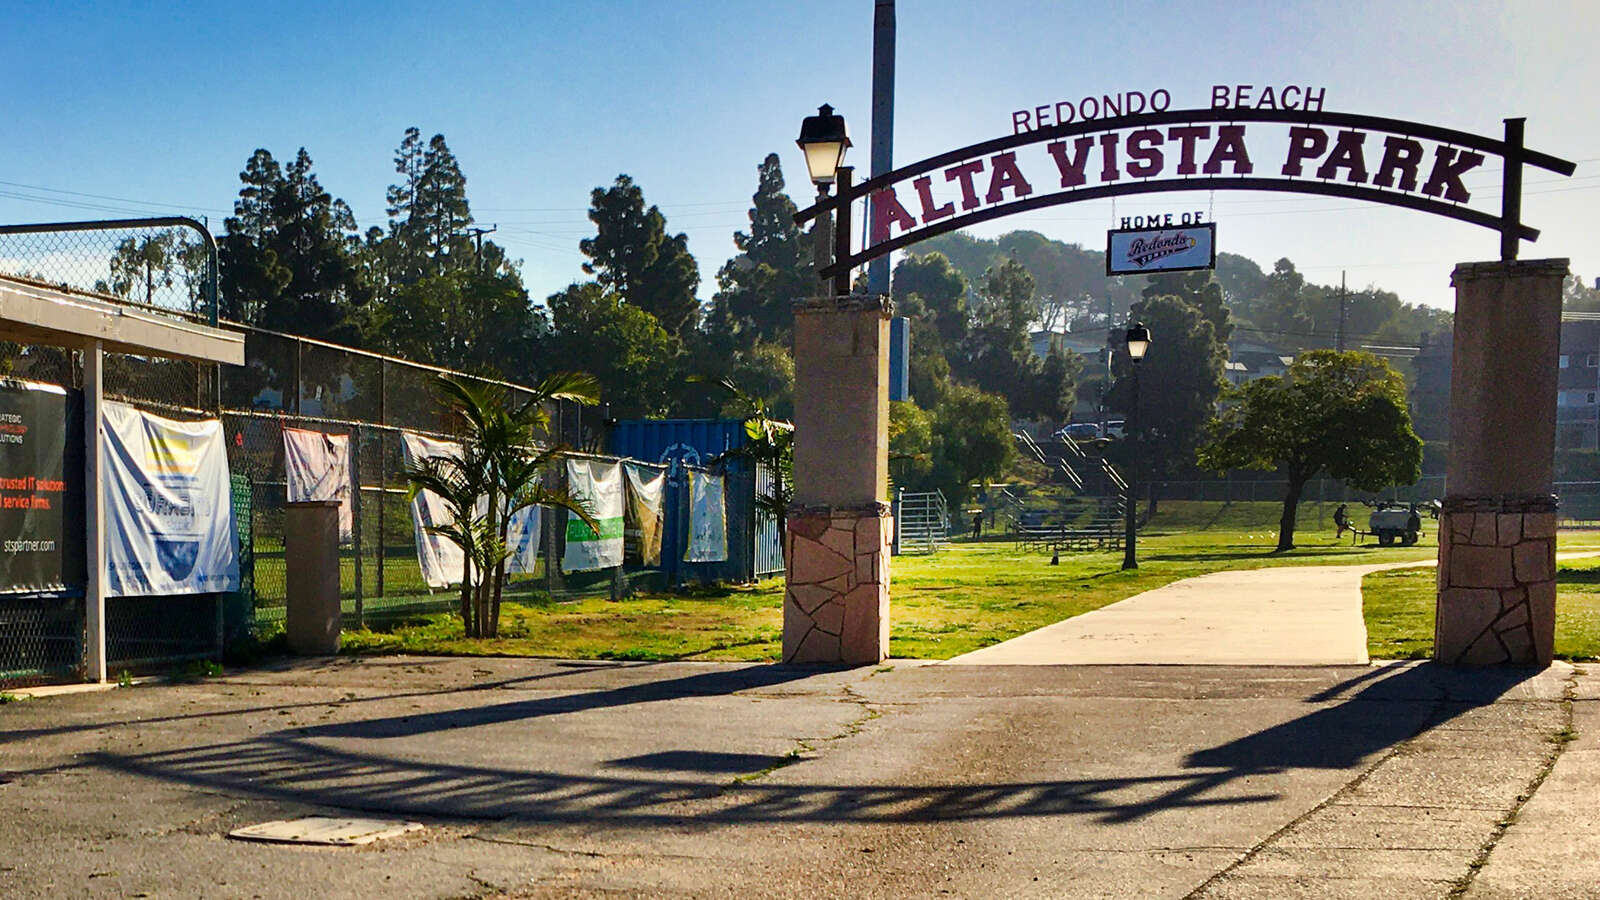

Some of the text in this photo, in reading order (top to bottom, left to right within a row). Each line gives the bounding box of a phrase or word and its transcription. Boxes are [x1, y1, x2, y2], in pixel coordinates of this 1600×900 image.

[1012, 84, 1326, 135] REDONDO BEACH
[870, 125, 1486, 242] ALTA VISTA PARK
[1120, 211, 1204, 229] HOME OF
[1127, 231, 1188, 257] Redondo
[0, 413, 22, 424] ATEGIC
[3, 495, 30, 509] service
[4, 540, 55, 556] stspartner.com
